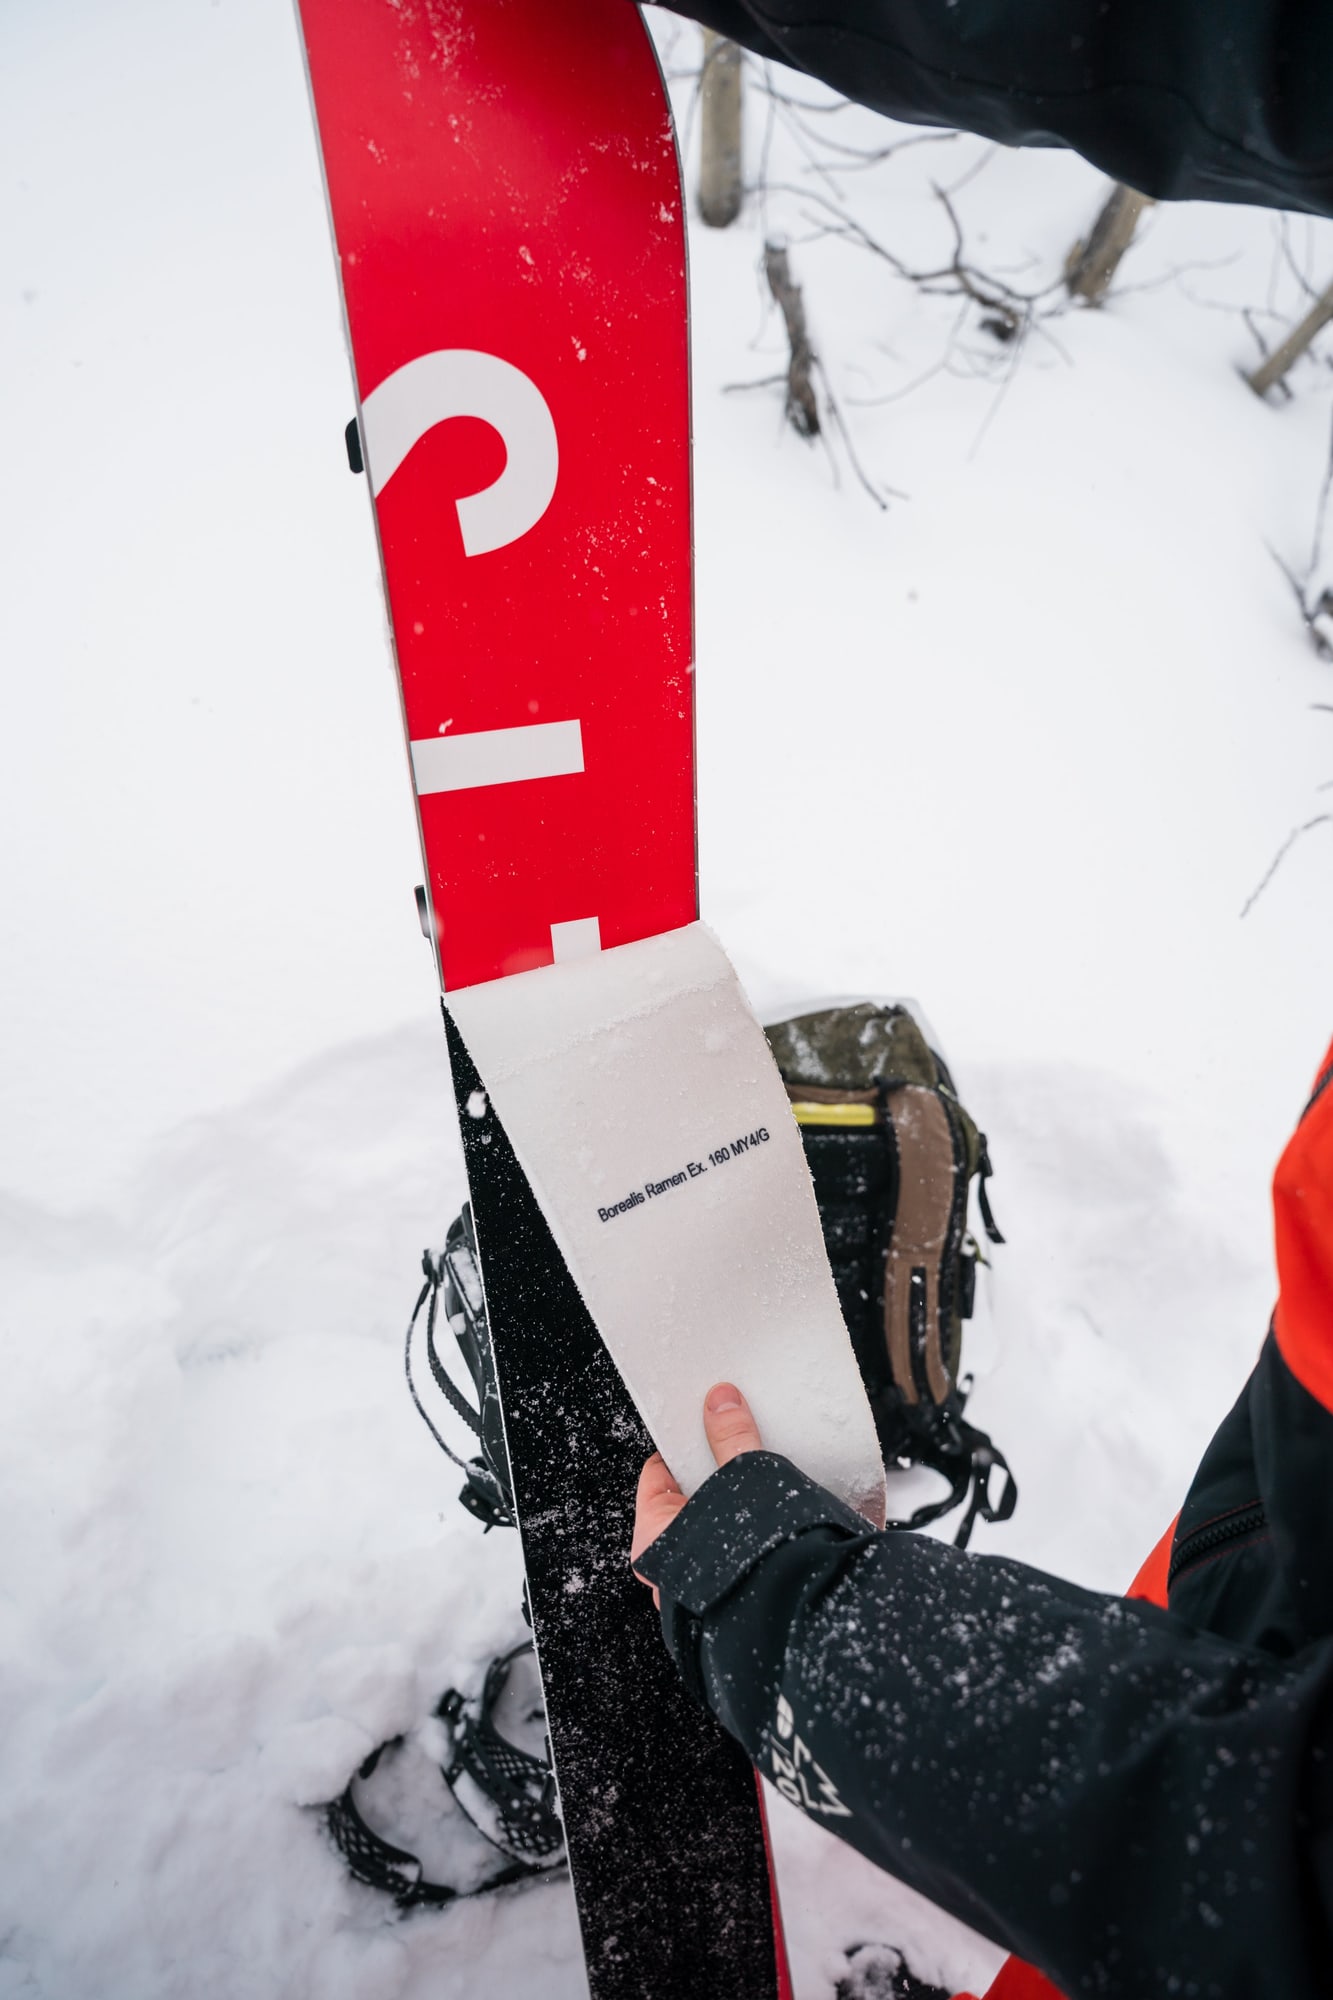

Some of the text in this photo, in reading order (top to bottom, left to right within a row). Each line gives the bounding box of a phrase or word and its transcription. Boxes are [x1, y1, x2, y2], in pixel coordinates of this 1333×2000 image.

[597, 1127, 770, 1223] Borealis Ramen Ex. 160 MY4/G
